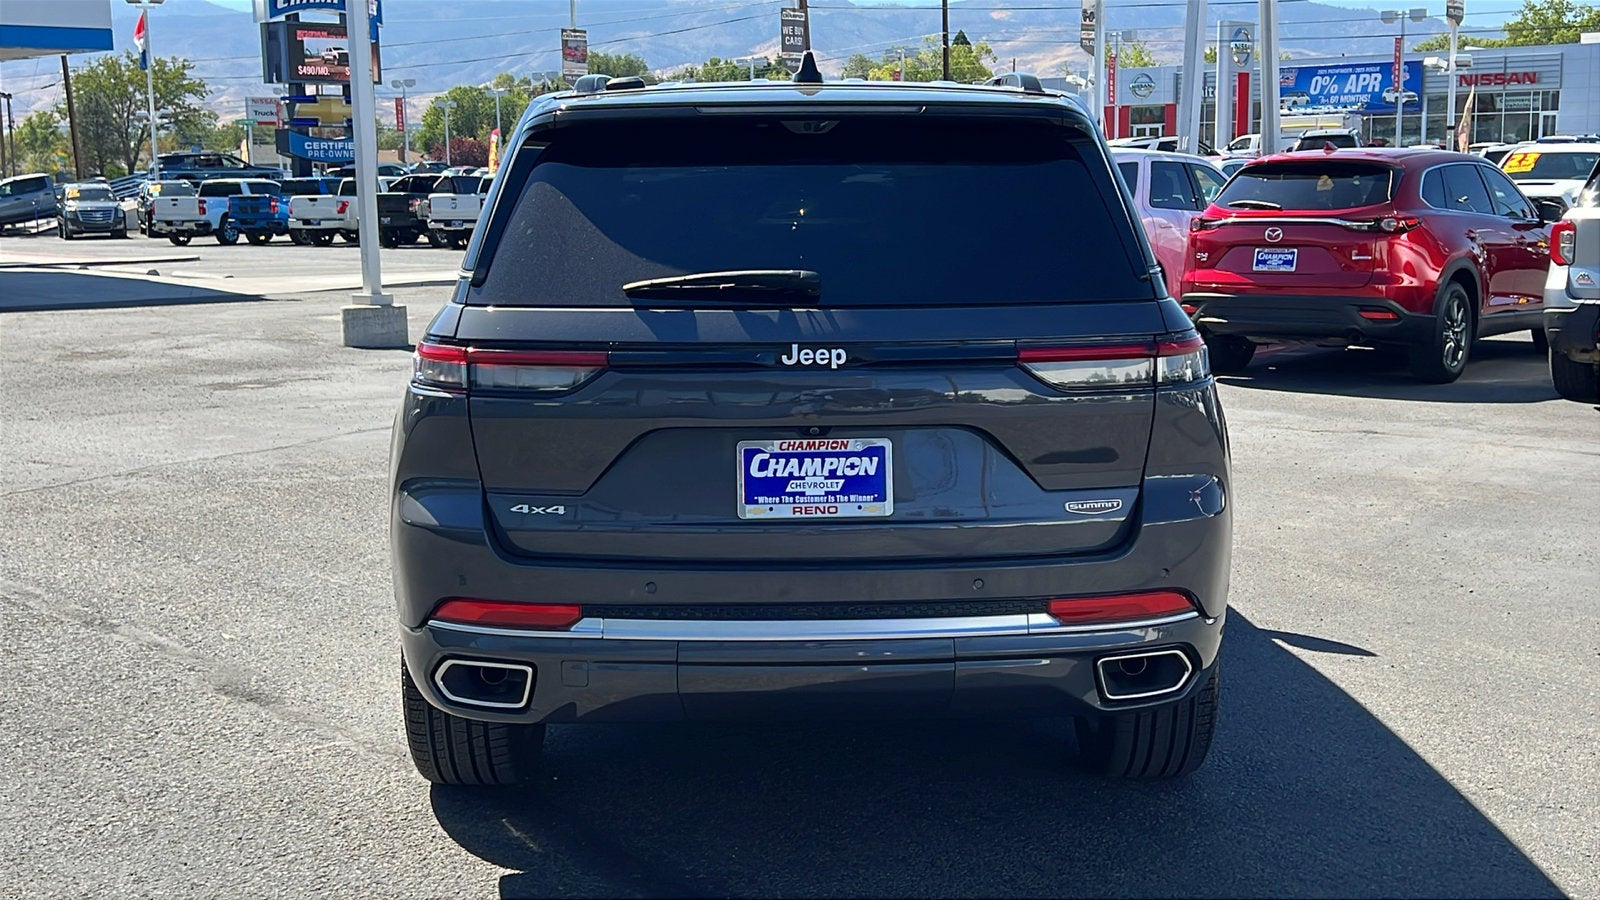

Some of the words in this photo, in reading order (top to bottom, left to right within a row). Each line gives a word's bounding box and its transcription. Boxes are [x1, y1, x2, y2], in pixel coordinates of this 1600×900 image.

[783, 26, 793, 35] WE
[1459, 71, 1537, 87] NISSAN
[1309, 75, 1338, 95] 0%
[1343, 73, 1382, 93] APR
[1340, 94, 1371, 103] MONTHS!
[304, 141, 355, 150] CERTIFIE
[781, 343, 847, 369] Jeep
[779, 440, 849, 451] CHAMPION
[750, 453, 879, 478] CHAMPION
[789, 481, 841, 490] CHEVROLET
[781, 496, 794, 504] The
[795, 495, 828, 503] Customer
[828, 495, 836, 503] Is
[836, 495, 849, 503] The
[510, 504, 567, 515] 4x4
[1069, 501, 1119, 510] SUMMIT
[792, 506, 838, 515] RENO
